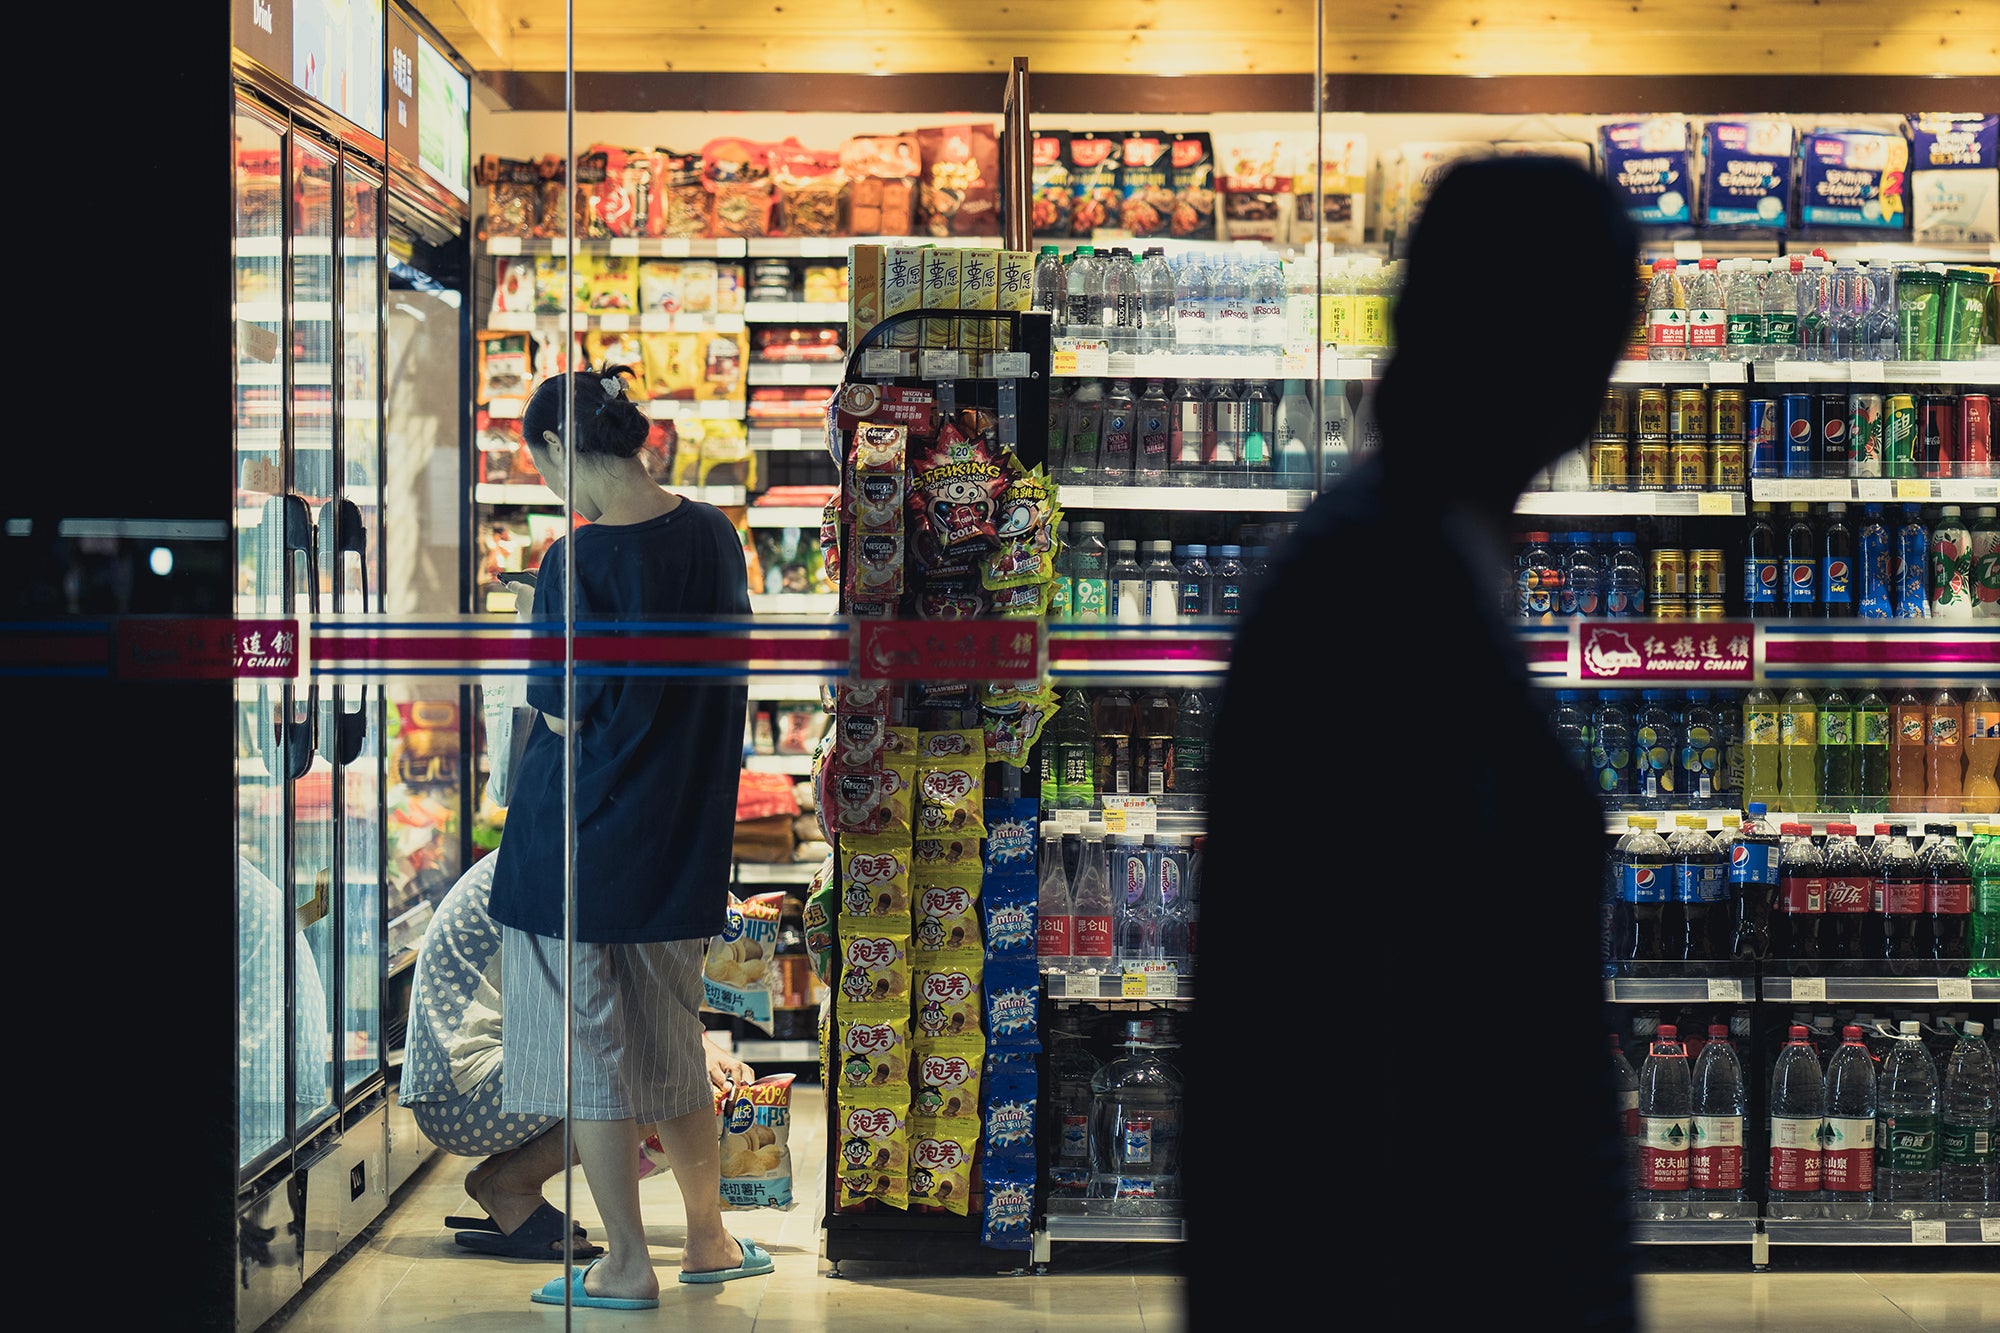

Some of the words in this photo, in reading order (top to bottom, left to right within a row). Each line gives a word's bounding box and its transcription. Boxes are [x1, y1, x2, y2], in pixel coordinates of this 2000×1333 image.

[254, 0, 272, 34] Drink
[1884, 171, 1905, 196] 2
[886, 257, 922, 290] 薯愿
[924, 258, 960, 291] 薯愿
[962, 260, 997, 292] 薯愿
[1000, 262, 1033, 293] 薯愿
[1252, 306, 1280, 315] MRsoda
[956, 448, 968, 456] 20
[910, 462, 1001, 491] STRIKING
[925, 478, 960, 492] POPPING
[960, 474, 990, 484] CANDY
[950, 526, 979, 542] COLA
[926, 564, 969, 576] STRAWBERRY
[1982, 557, 1997, 579] 7
[1078, 582, 1099, 604] 9.0
[1644, 635, 1750, 658] 红旗连锁
[247, 657, 291, 667] CHAIN
[1646, 660, 1700, 670] HONGQI
[1703, 660, 1748, 670] CHAIN
[932, 737, 962, 752] 泡芙
[928, 772, 967, 794] 泡芙
[998, 828, 1023, 838] mini
[853, 858, 892, 878] 泡芙
[925, 890, 965, 911] 泡芙
[996, 912, 1023, 924] mini
[1078, 920, 1108, 934] 昆仑山
[744, 920, 778, 942] HIPS
[851, 942, 892, 962] 泡芙
[926, 976, 967, 997] 泡芙
[998, 998, 1025, 1010] mini
[852, 1028, 891, 1049] 泡芙
[926, 1060, 965, 1081] 泡芙
[755, 1086, 787, 1105] 20%
[756, 1106, 788, 1128] HIPS
[852, 1112, 892, 1132] 泡芙
[997, 1111, 1023, 1122] mini
[918, 1144, 959, 1166] 泡芙
[998, 1196, 1023, 1206] mini
